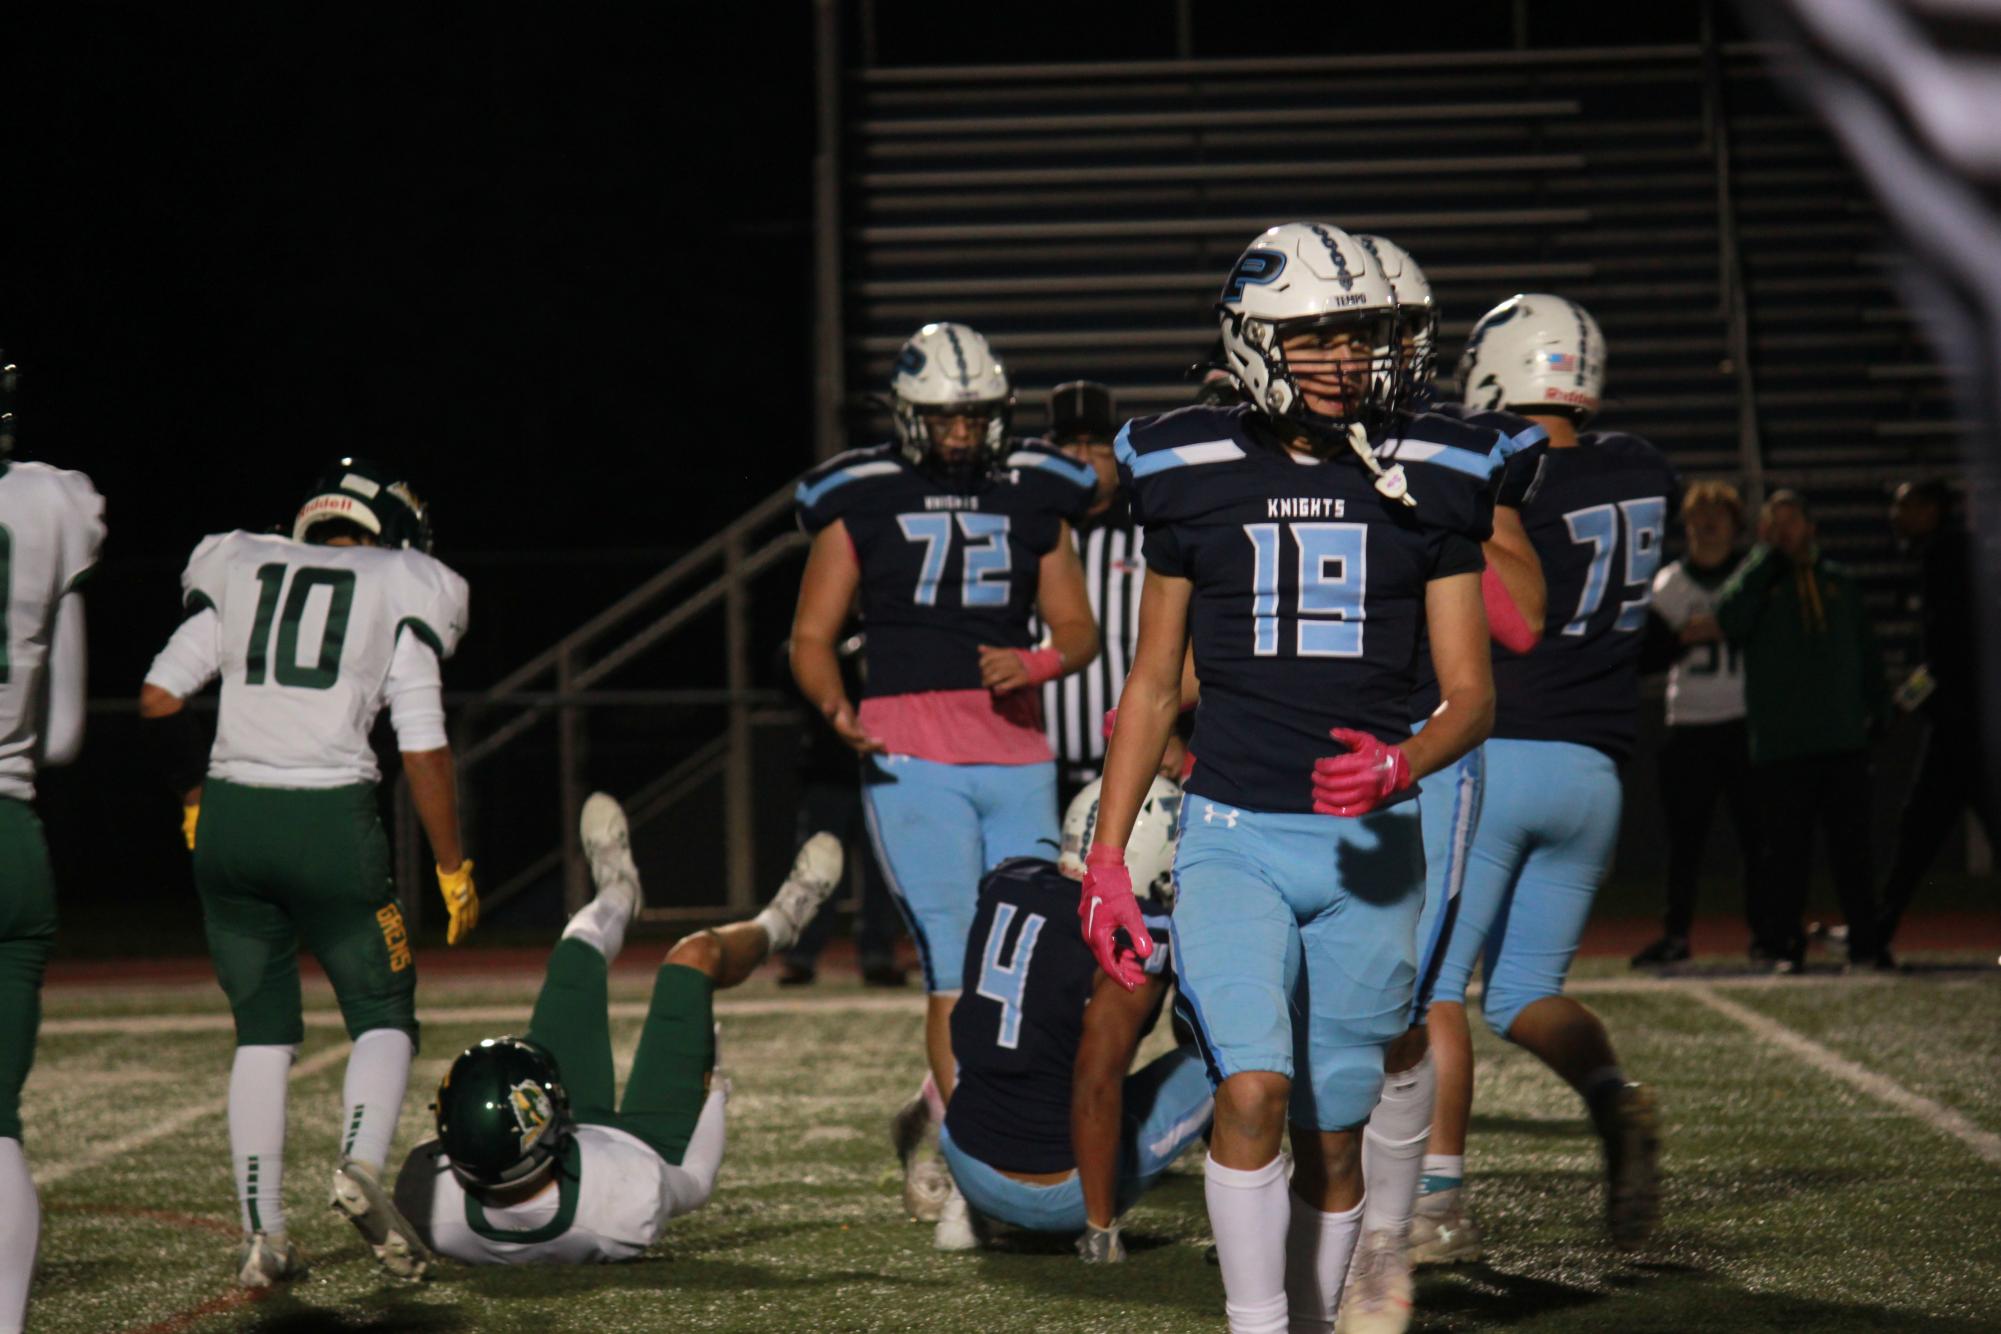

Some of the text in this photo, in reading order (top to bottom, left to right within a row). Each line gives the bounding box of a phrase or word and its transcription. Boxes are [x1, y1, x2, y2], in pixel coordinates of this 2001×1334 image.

[895, 511, 1012, 608] 72
[1267, 498, 1345, 518] KNIGHTS
[1560, 496, 1667, 636] 79
[245, 562, 356, 690] 10
[1242, 522, 1368, 659] 19
[976, 901, 1048, 1050] 4
